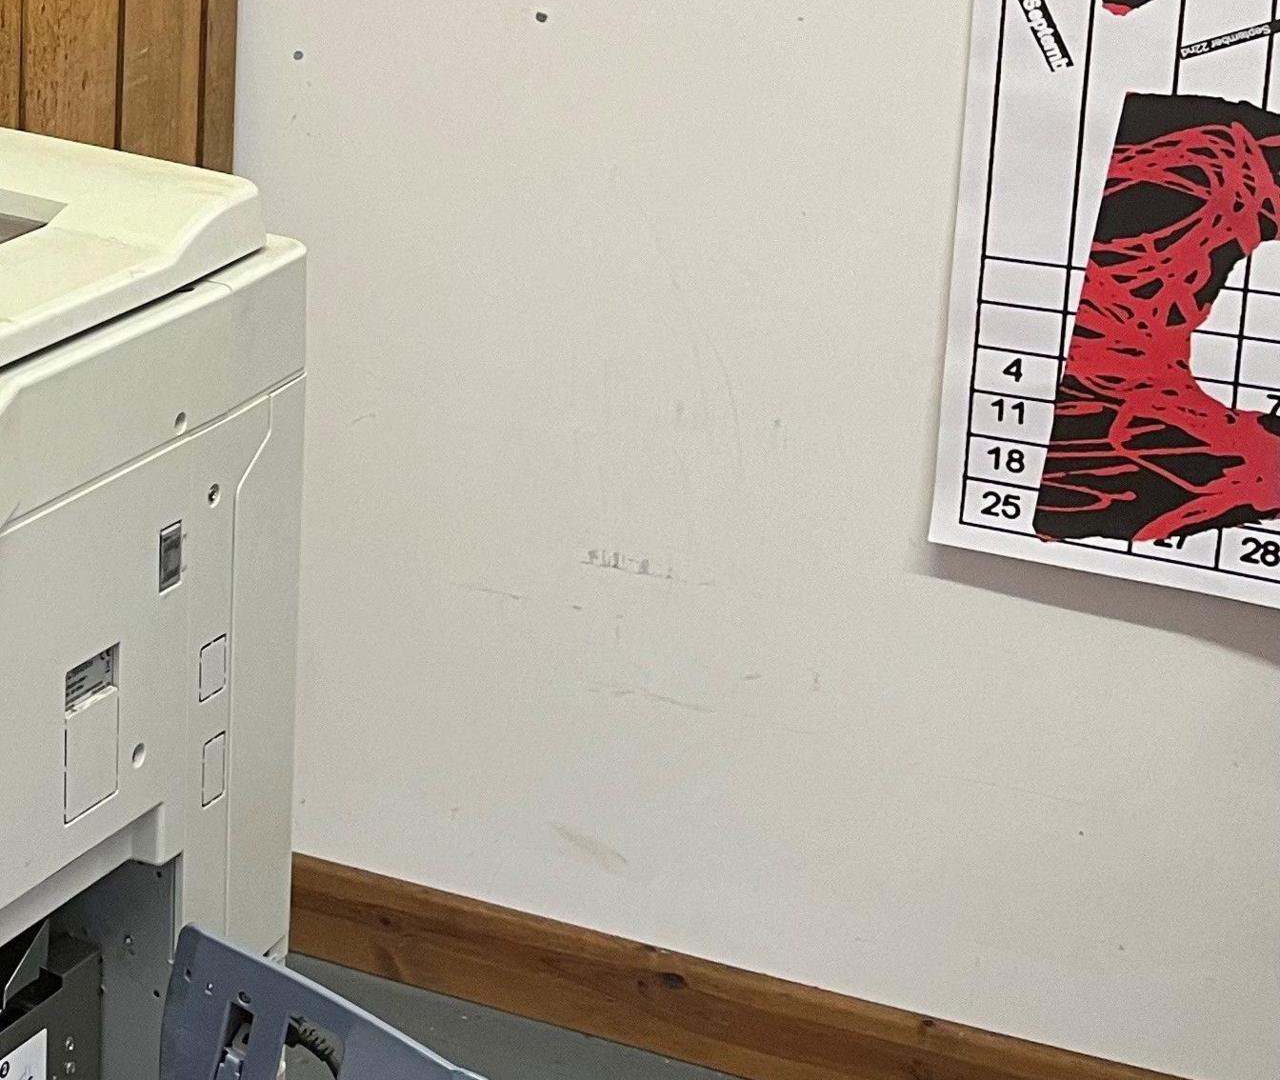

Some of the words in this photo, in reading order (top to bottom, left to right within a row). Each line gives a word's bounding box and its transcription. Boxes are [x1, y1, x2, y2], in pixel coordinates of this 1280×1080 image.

[1211, 24, 1271, 48] September
[1179, 42, 1209, 59] 22nd
[1001, 357, 1023, 382] 4
[990, 399, 1026, 425] 11
[986, 446, 1026, 474] 18
[980, 491, 1021, 520] 25
[1240, 537, 1280, 567] 28
